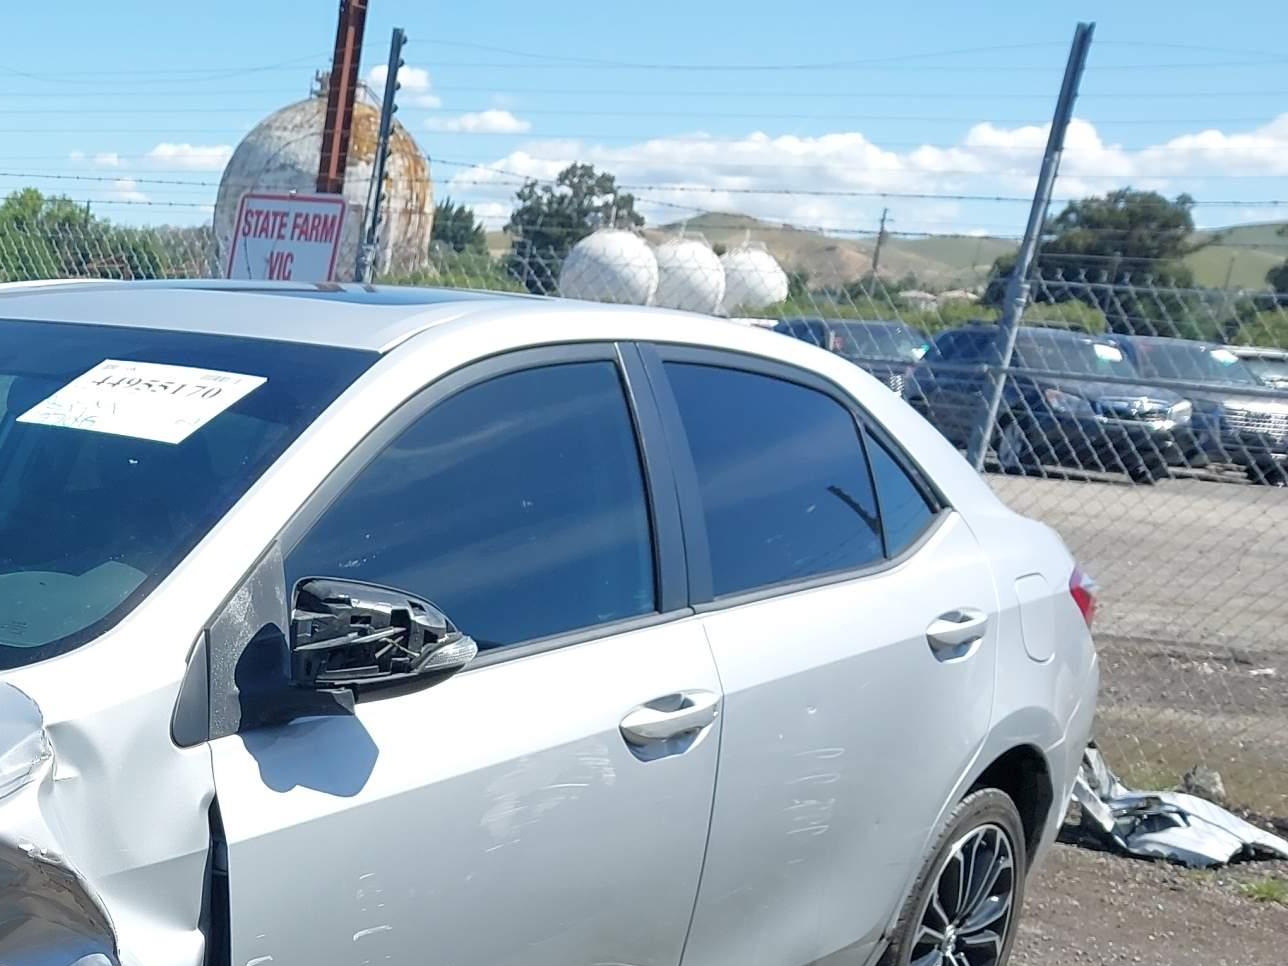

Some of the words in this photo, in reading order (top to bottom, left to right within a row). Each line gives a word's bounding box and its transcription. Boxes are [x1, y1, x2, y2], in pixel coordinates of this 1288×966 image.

[243, 209, 289, 240] STATE
[291, 211, 337, 243] FARM
[268, 250, 294, 280] VIC
[92, 375, 223, 399] 44955170
